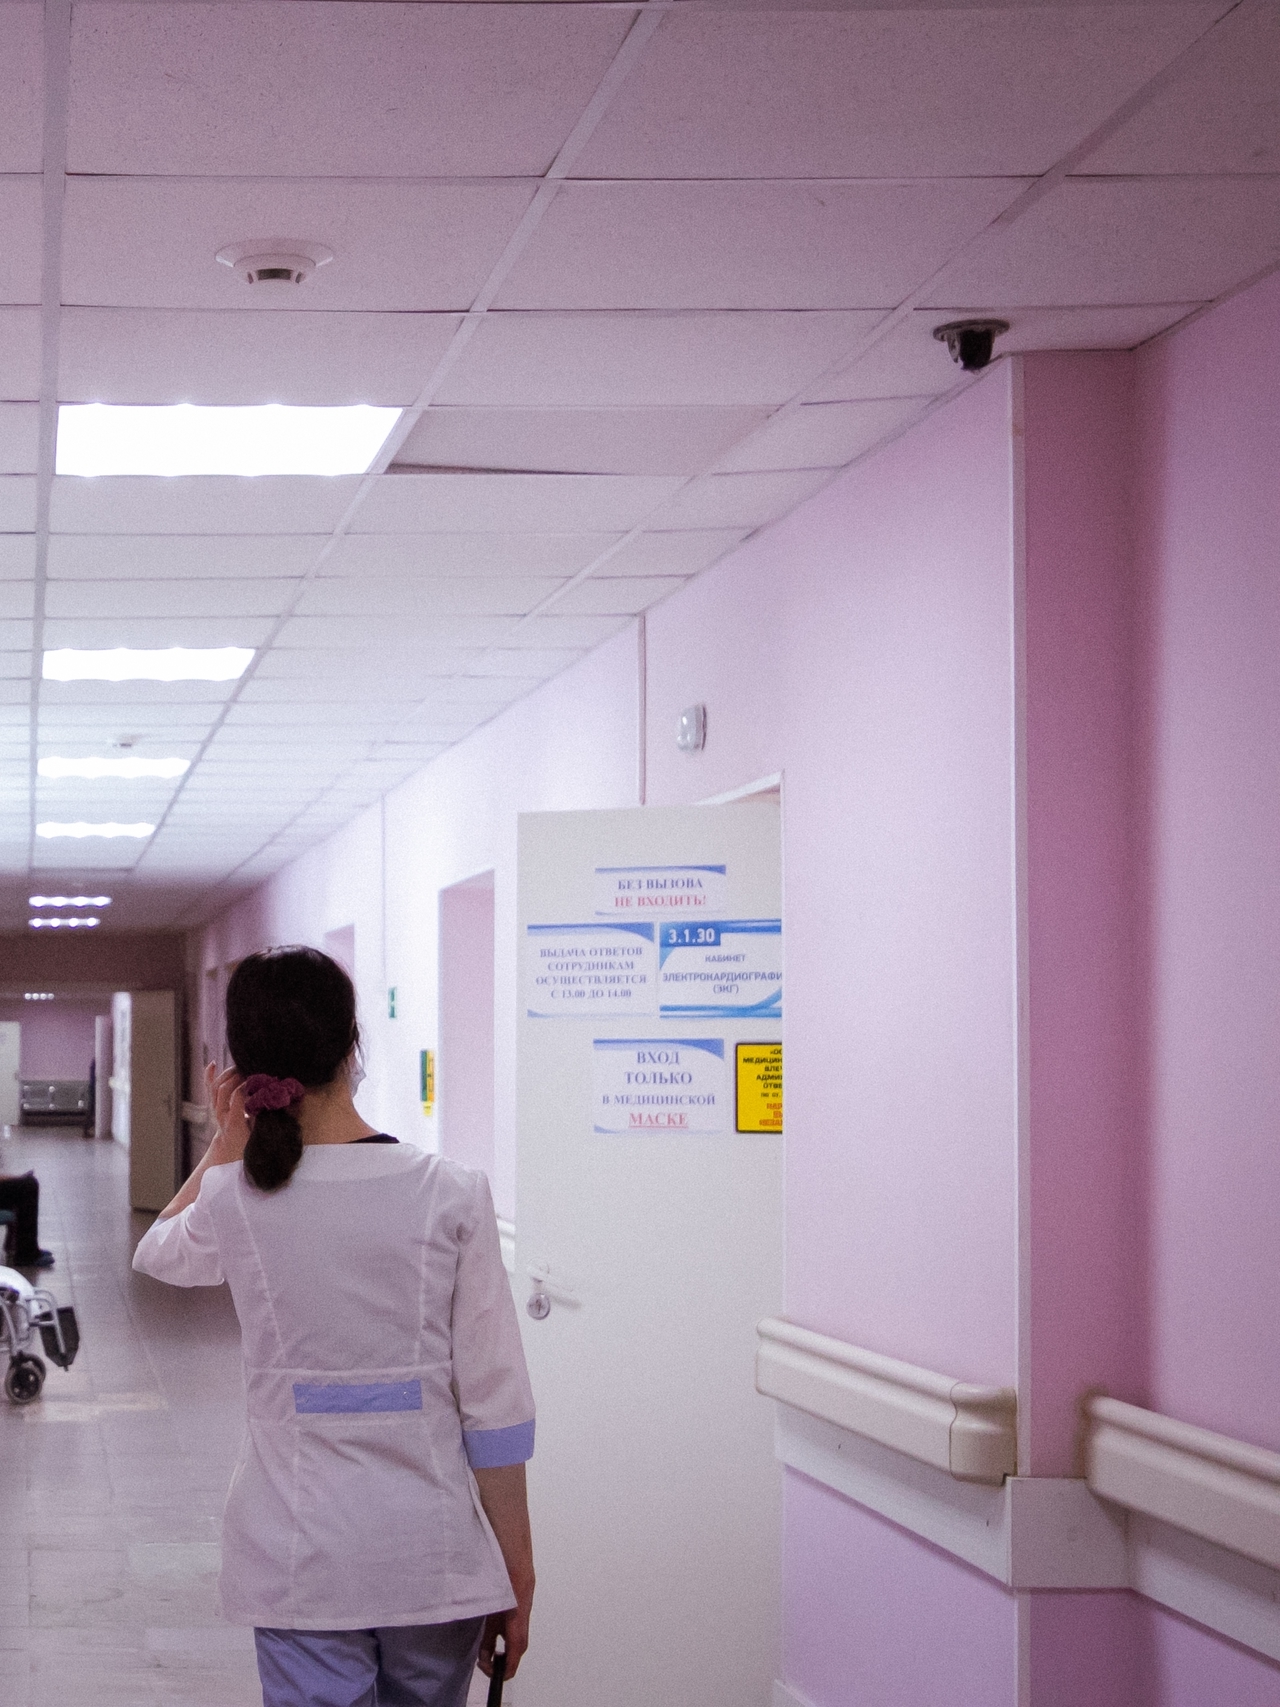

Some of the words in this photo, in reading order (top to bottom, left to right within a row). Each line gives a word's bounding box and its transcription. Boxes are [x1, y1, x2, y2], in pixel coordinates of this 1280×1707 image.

[617, 879, 642, 890] БЕЗ
[646, 878, 703, 889] ВЫЗОВА
[614, 896, 632, 907] НЕ
[637, 895, 706, 907] ВХОДИТЬ!
[668, 928, 715, 943] 3.1.30
[540, 948, 586, 958] ВЫДАЧА
[589, 947, 643, 956] ОТВЕТОВ
[705, 954, 746, 962] КАБИНЕТ
[547, 961, 634, 971] СОТРУДНИКАМ
[535, 975, 647, 985] ОСУЩЕСТВЛЯЕТСЯ
[550, 990, 556, 998] С
[588, 989, 604, 999] ДО
[713, 984, 739, 994] (ЭКГ)
[636, 1051, 680, 1065] ВХОД
[624, 1071, 692, 1084] ТОЛЬКО
[602, 1095, 610, 1105] В
[614, 1093, 715, 1105] МЕДИЦИНСКОЙ
[629, 1112, 688, 1127] МАСКЕ
